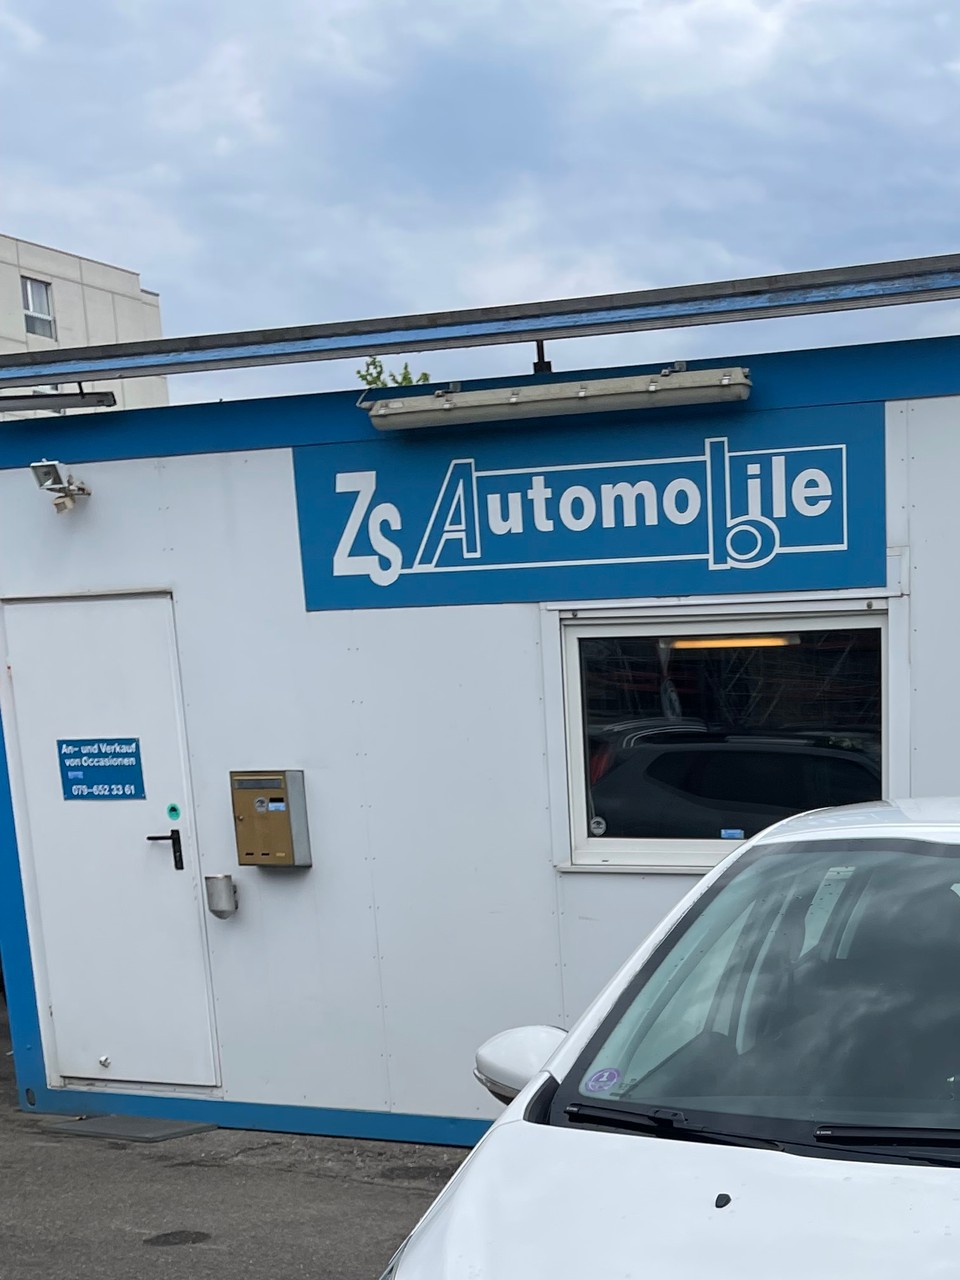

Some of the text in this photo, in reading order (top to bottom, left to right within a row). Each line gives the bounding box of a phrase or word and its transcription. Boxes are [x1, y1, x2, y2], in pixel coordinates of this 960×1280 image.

[412, 437, 835, 570] Automobile
[81, 743, 98, 754] und
[100, 742, 136, 753] Verkauf
[64, 755, 136, 767] von Occasionen
[111, 784, 123, 795] 33
[124, 784, 135, 795] 61
